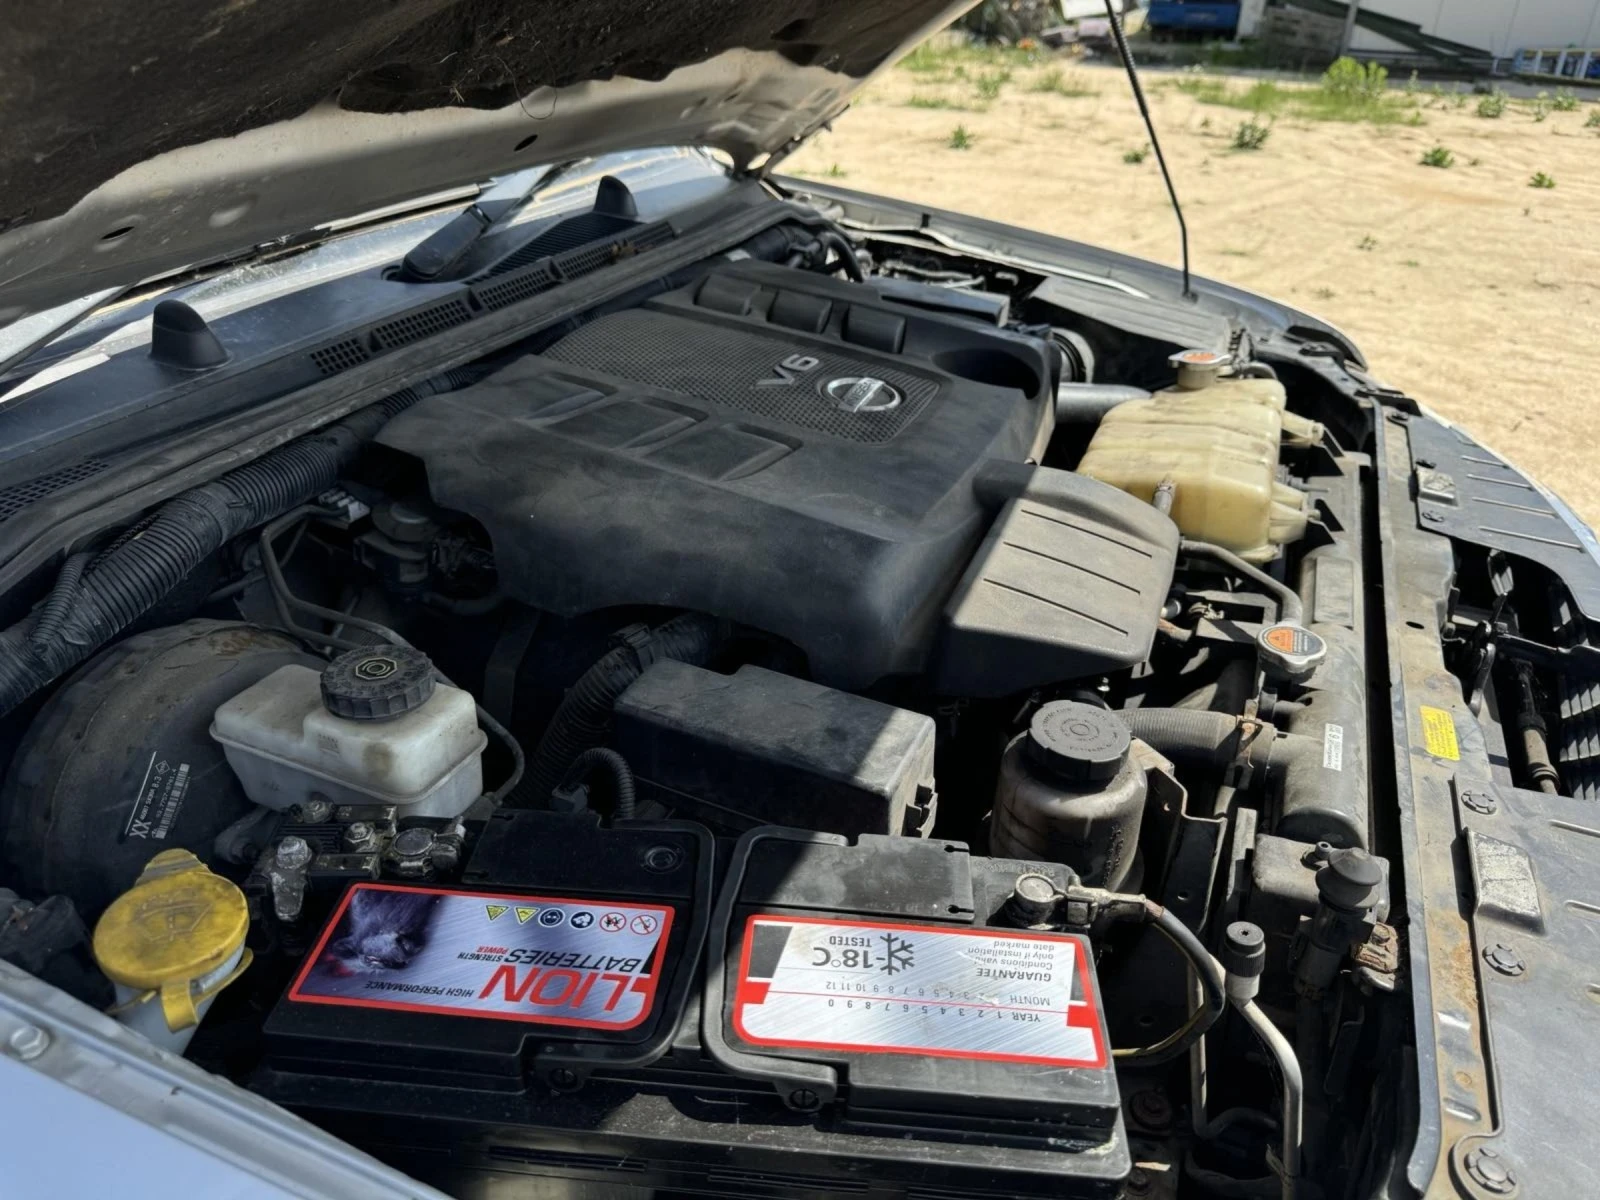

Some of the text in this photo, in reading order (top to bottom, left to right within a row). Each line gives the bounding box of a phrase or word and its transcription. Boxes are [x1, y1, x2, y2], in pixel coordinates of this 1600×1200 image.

[755, 354, 819, 387] V6
[129, 819, 152, 839] XX
[829, 936, 872, 948] TESTED
[994, 940, 1030, 950] marked
[477, 946, 509, 954] POWER
[968, 947, 1022, 957] installation
[457, 952, 504, 962] STRENGTH
[1032, 952, 1054, 960] only
[504, 948, 642, 973] BATTERIES
[1000, 960, 1053, 970] Conditions
[976, 968, 1052, 982] GUARANTEE
[364, 980, 474, 998] HIGH PERFORMANCE
[478, 964, 632, 1011] LION
[826, 982, 836, 990] 12
[841, 982, 850, 990] 11
[856, 983, 866, 992] 10
[874, 984, 878, 992] 9
[888, 986, 894, 994] 8
[904, 986, 908, 994] 7
[918, 988, 924, 996] 6
[964, 992, 969, 1000] 3
[828, 999, 834, 1007] 0
[847, 1000, 852, 1008] 9
[1010, 994, 1050, 1006] MONTH
[866, 1002, 871, 1010] 8
[885, 1003, 890, 1011] 7
[903, 1004, 908, 1012] 6
[922, 1006, 928, 1014] 5
[958, 1008, 964, 1016] 3
[978, 1010, 984, 1018] 2
[1012, 1012, 1040, 1022] YEAR
